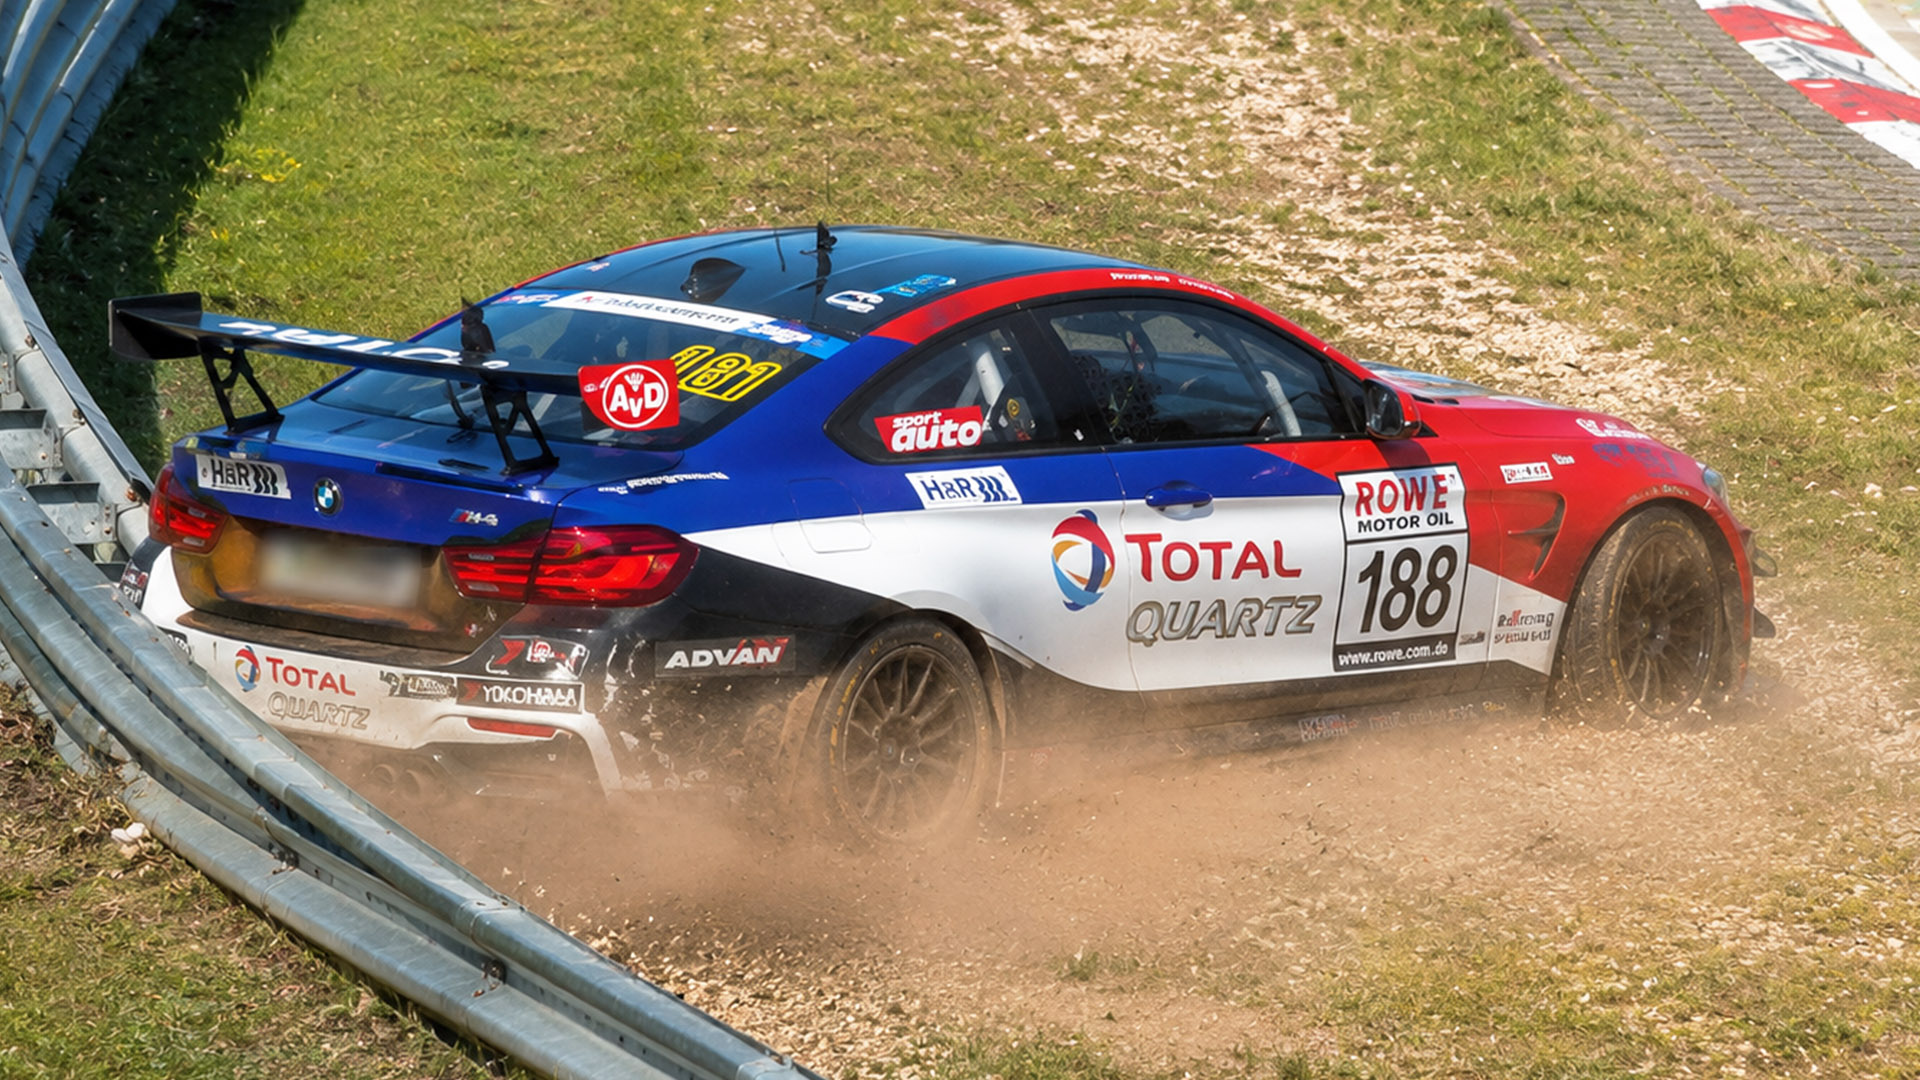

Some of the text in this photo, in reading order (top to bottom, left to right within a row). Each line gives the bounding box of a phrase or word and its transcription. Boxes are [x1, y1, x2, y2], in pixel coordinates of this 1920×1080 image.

[891, 419, 983, 453] auto
[892, 411, 942, 434] sport
[1355, 473, 1448, 517] ROWE
[1357, 511, 1454, 534] MOTOR OIL
[1125, 533, 1303, 583] TOTAL
[1358, 544, 1458, 634] 188
[1126, 594, 1323, 648] QUARTZ
[664, 638, 790, 670] ADVAN
[265, 656, 356, 697] TOTAL
[267, 690, 371, 730] QUARTZ
